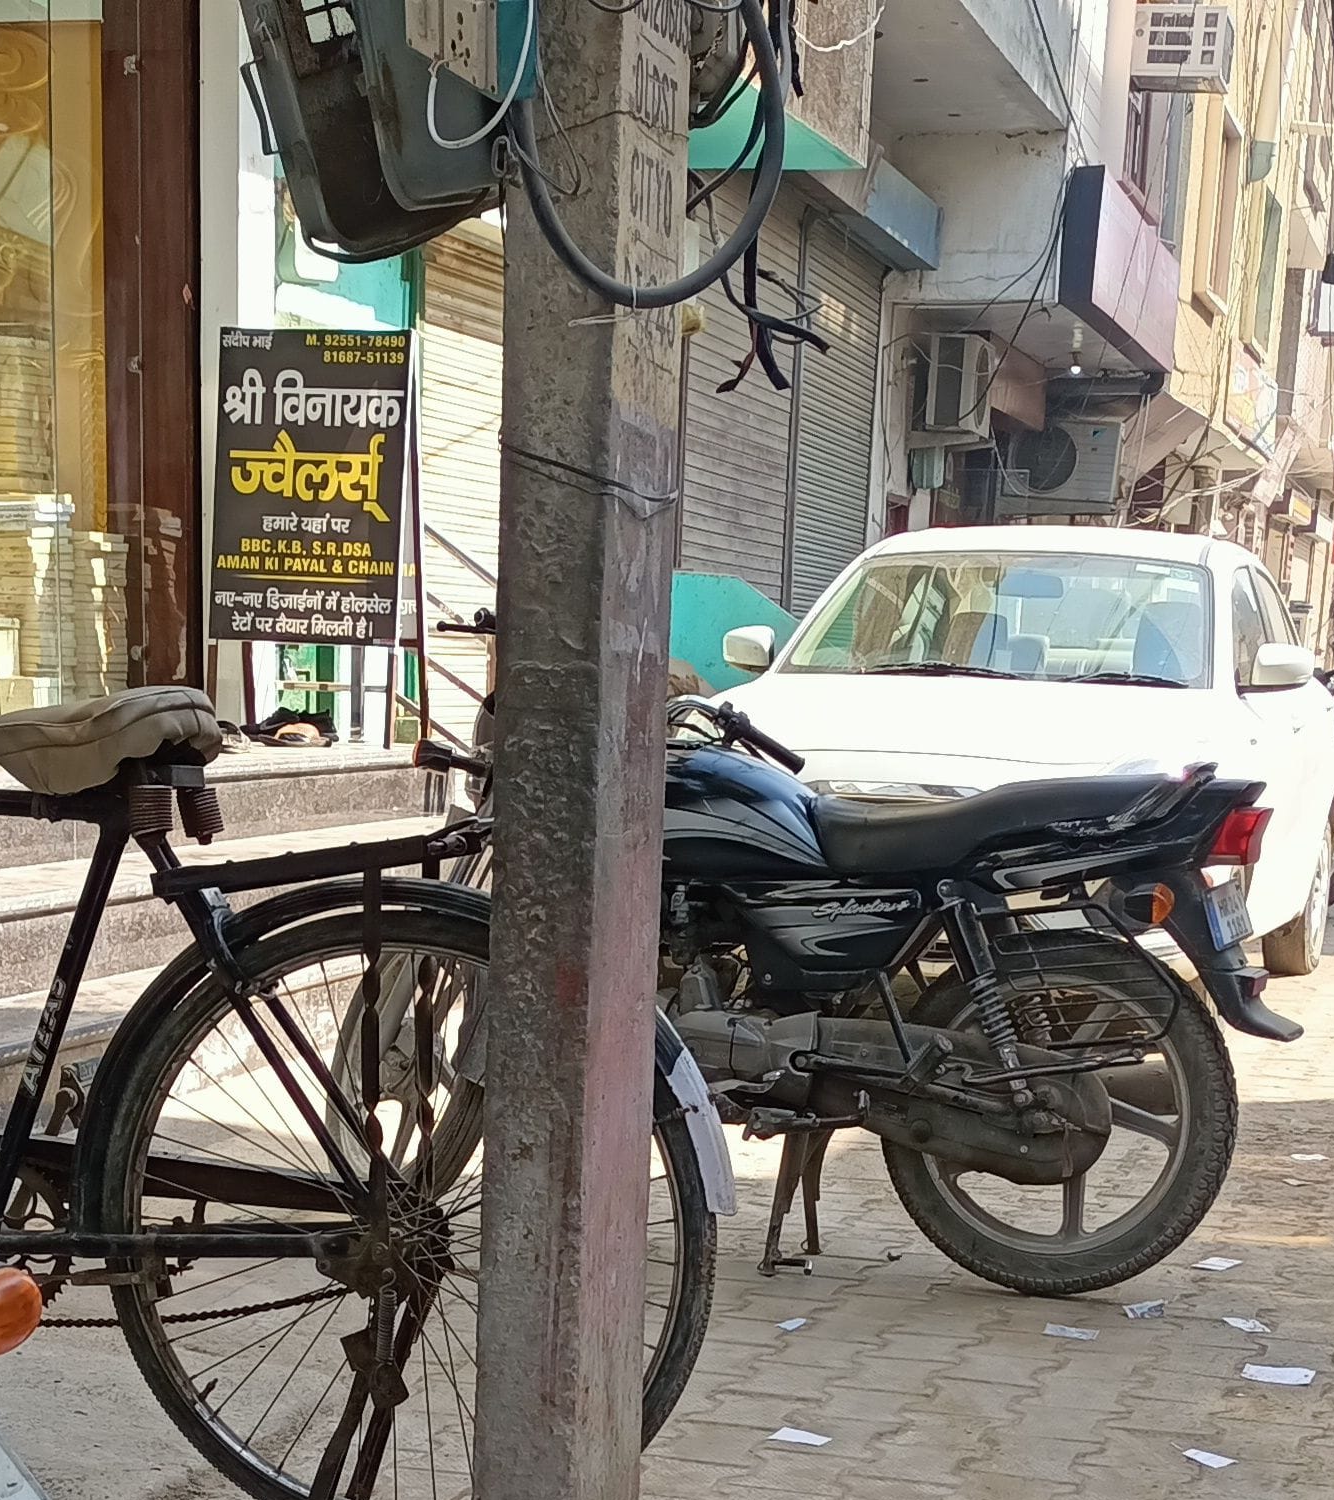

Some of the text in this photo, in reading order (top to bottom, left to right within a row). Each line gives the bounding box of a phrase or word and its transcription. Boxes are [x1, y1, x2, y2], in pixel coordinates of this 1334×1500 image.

[252, 331, 273, 349] भाई
[324, 334, 406, 348] 92551-78490
[323, 351, 405, 364] 81687-51139
[222, 368, 405, 428] श्री विनायक
[262, 512, 298, 532] हमारे
[331, 517, 351, 534] पर
[216, 554, 394, 576] AMAN KI PAYAL & CHAIN
[325, 590, 340, 611] में
[341, 591, 393, 615] होलसेल
[255, 616, 274, 632] पर
[275, 612, 309, 635] तैयार
[310, 613, 353, 638] मिलती
